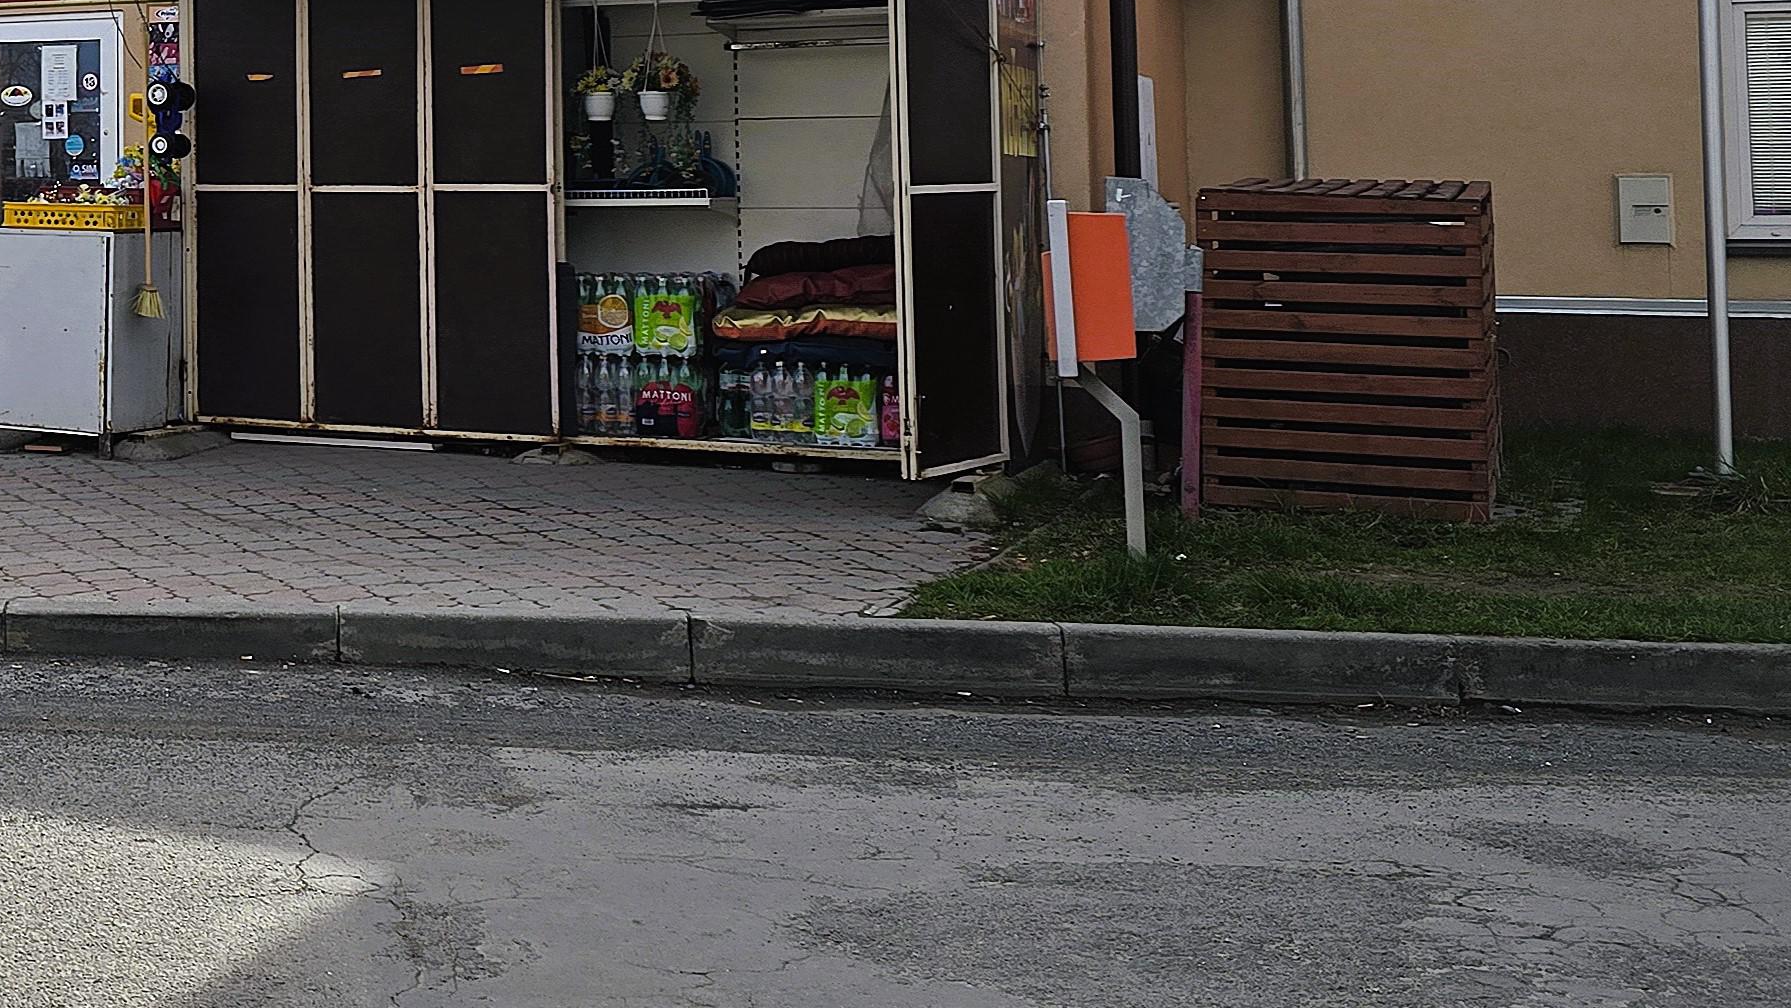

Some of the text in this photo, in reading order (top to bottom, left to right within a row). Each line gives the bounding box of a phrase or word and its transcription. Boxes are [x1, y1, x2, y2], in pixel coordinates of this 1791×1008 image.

[641, 300, 649, 344] MATTONI
[581, 334, 632, 346] MATTONI
[641, 390, 692, 402] MATTONI
